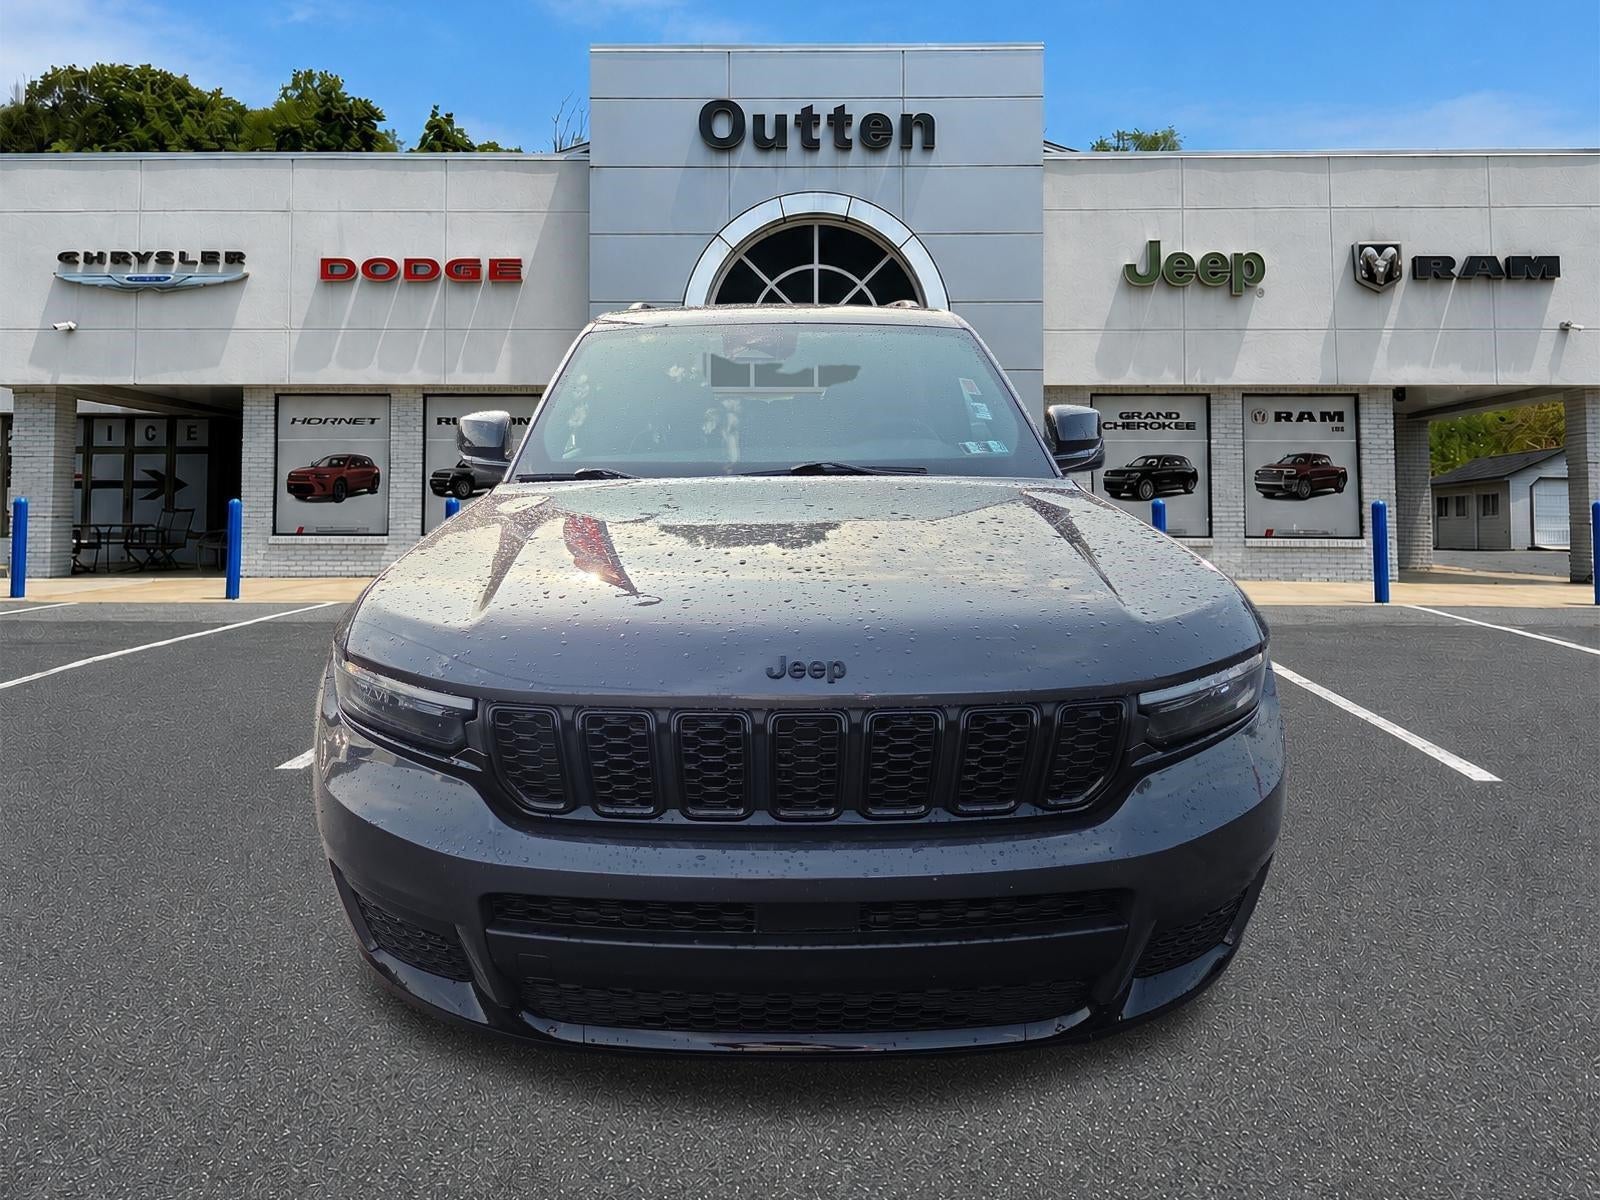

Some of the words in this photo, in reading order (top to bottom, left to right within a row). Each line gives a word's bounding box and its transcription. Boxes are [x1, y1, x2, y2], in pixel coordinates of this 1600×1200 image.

[699, 99, 935, 150] Outten
[57, 250, 247, 266] CHRYSLER
[1124, 240, 1266, 296] Jeep
[1411, 255, 1560, 280] RAM
[320, 257, 523, 282] DODGE
[290, 417, 381, 425] HORNET
[1102, 421, 1197, 431] CHEROKEE
[1118, 411, 1181, 421] GRAND
[1274, 411, 1345, 423] RAM
[765, 655, 847, 684] Jeep
